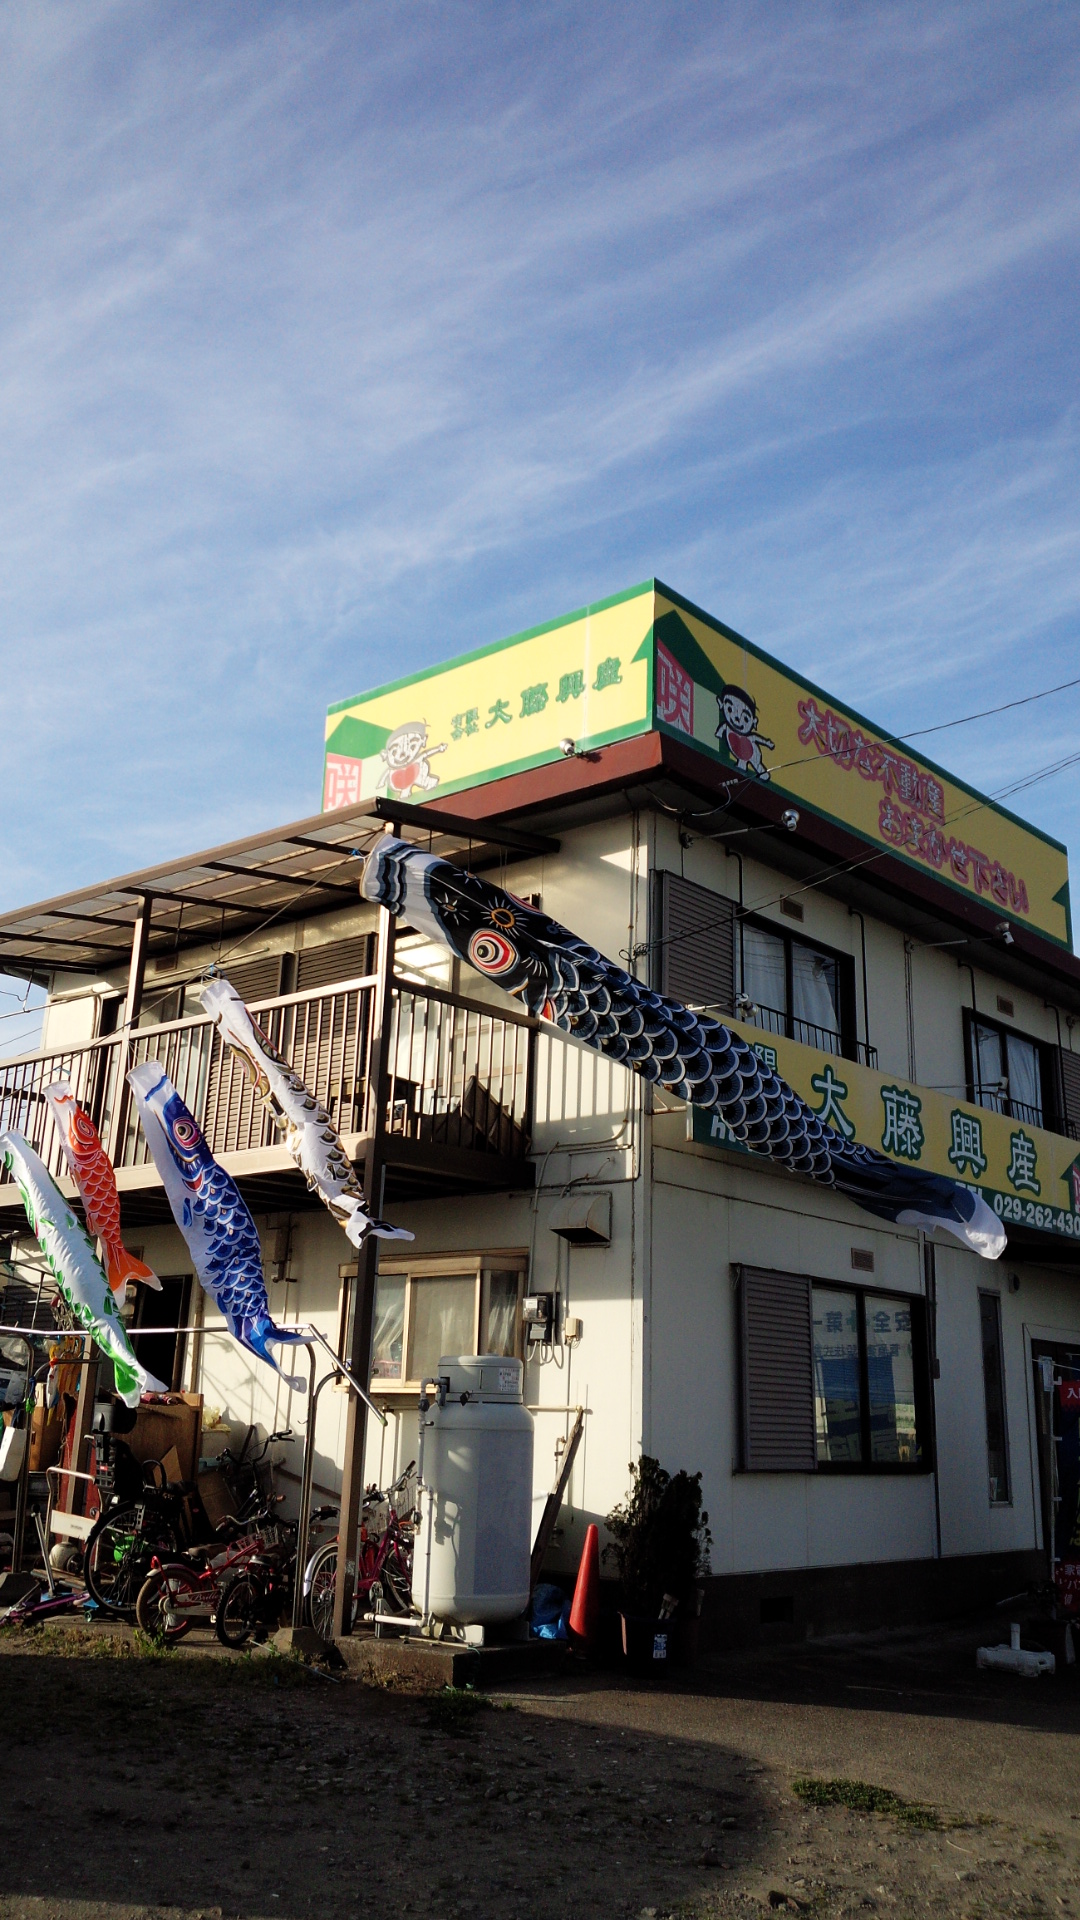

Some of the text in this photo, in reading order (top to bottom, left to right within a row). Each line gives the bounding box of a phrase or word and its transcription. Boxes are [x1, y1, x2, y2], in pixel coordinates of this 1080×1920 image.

[799, 699, 944, 822] 大切な不動産
[880, 798, 1029, 913] おまかせ下さい
[812, 1066, 1040, 1194] 大藤興産
